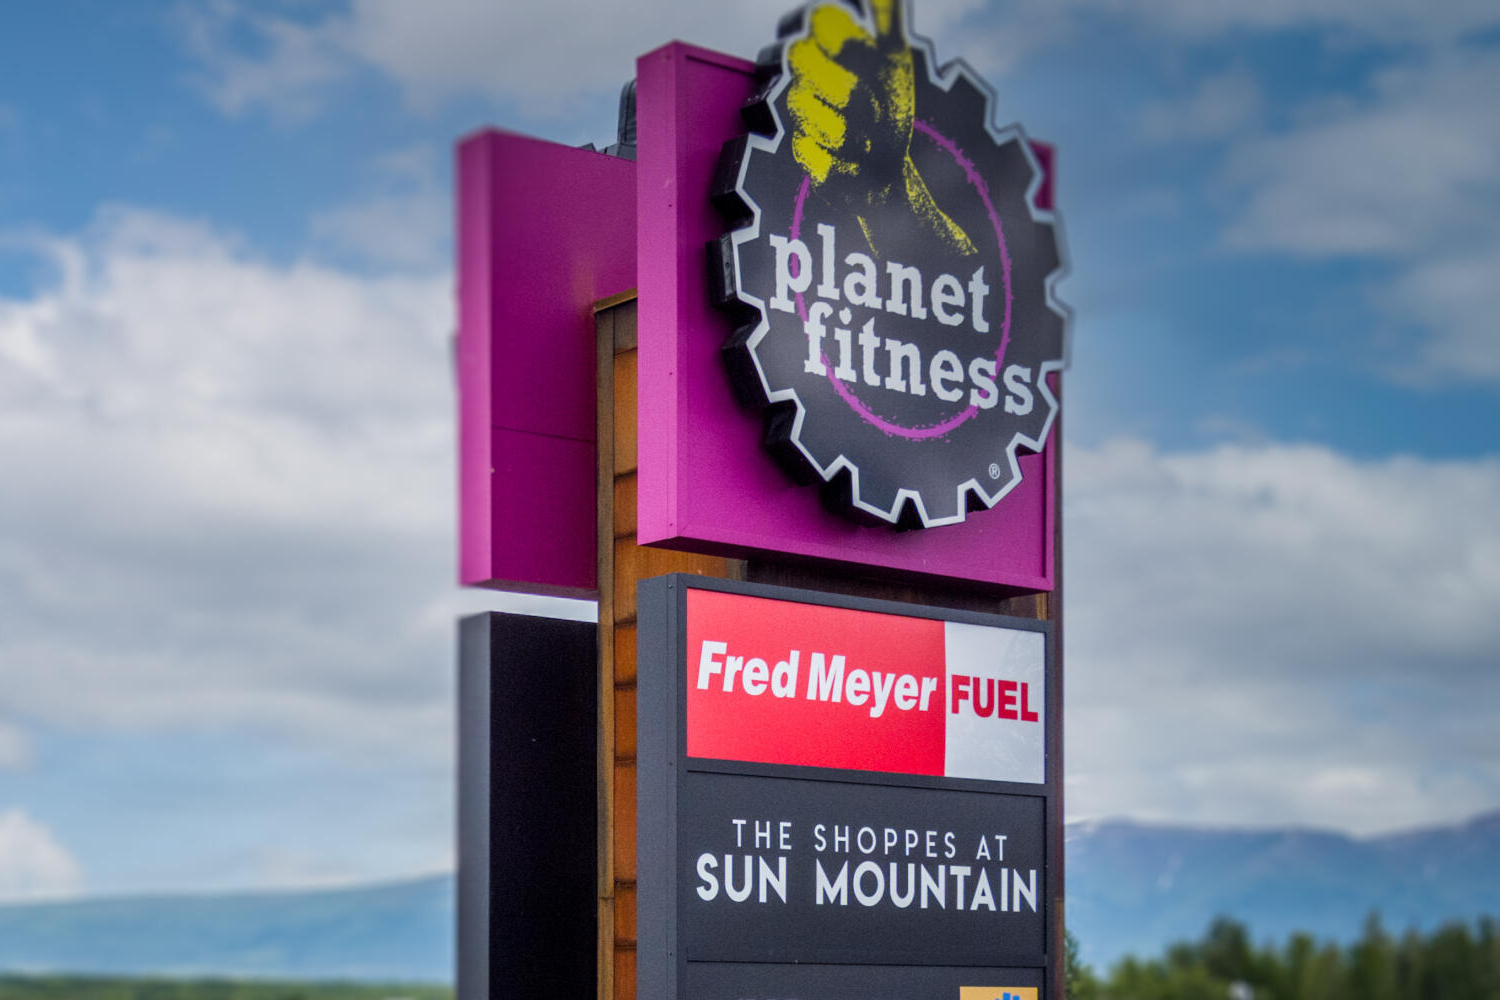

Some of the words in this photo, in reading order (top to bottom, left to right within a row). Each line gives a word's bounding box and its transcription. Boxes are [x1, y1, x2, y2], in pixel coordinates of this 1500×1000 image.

[768, 223, 990, 333] planet
[804, 301, 1034, 416] fitness
[697, 640, 800, 698] Fred
[806, 652, 937, 718] Meyer
[951, 674, 1039, 722] FUEL
[732, 819, 792, 850] THE
[814, 824, 956, 858] SHOPPES
[976, 835, 1007, 861] AT
[696, 853, 787, 903] SUN
[815, 861, 1037, 913] MOUNTAIN
